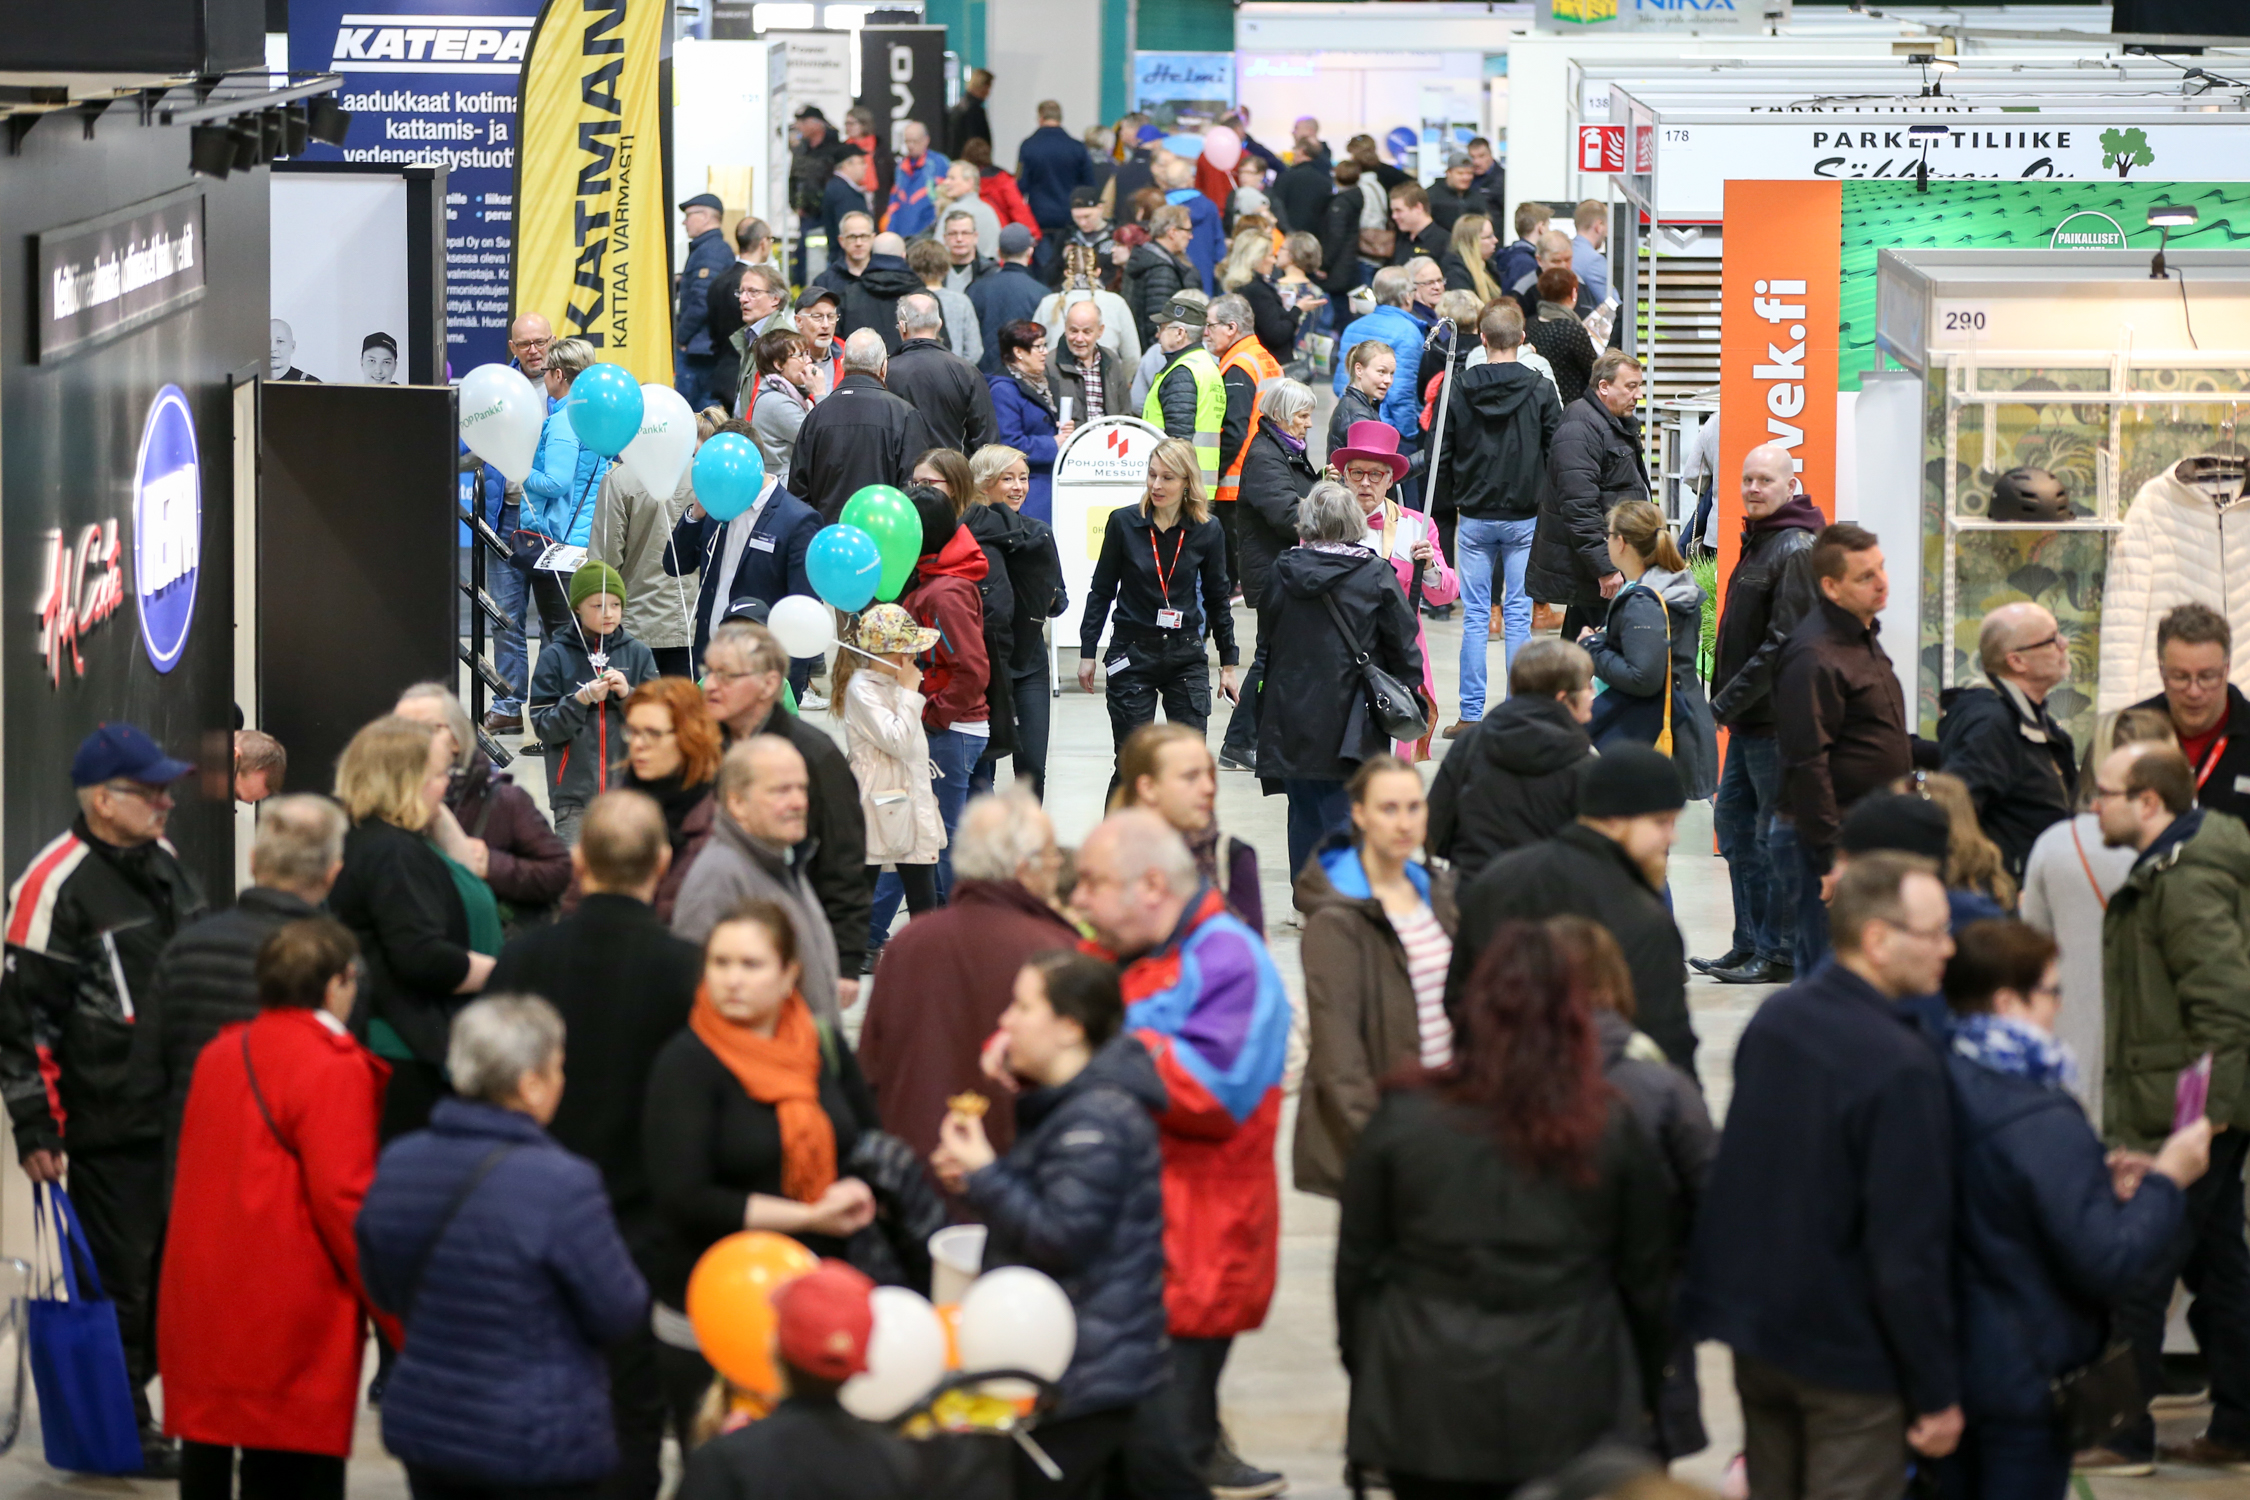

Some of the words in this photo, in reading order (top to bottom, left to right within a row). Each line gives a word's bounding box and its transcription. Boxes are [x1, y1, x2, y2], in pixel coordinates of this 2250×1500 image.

[1589, 98, 1610, 109] 138
[386, 118, 484, 140] kattamis-
[487, 119, 509, 145] ja
[1665, 130, 1690, 142] 178
[566, 0, 627, 348] KATMAN
[613, 135, 634, 253] VARMASTI
[466, 236, 479, 250] Oy
[481, 240, 494, 248] on
[2058, 233, 2120, 244] PAIKALLISET
[612, 261, 630, 349] KATTAA
[1946, 312, 1986, 330] 290
[1753, 279, 1806, 495] vek.fi
[475, 402, 503, 423] Pankki
[1067, 459, 1148, 468] POHJOIS-SUO
[1092, 526, 1105, 534] OH
